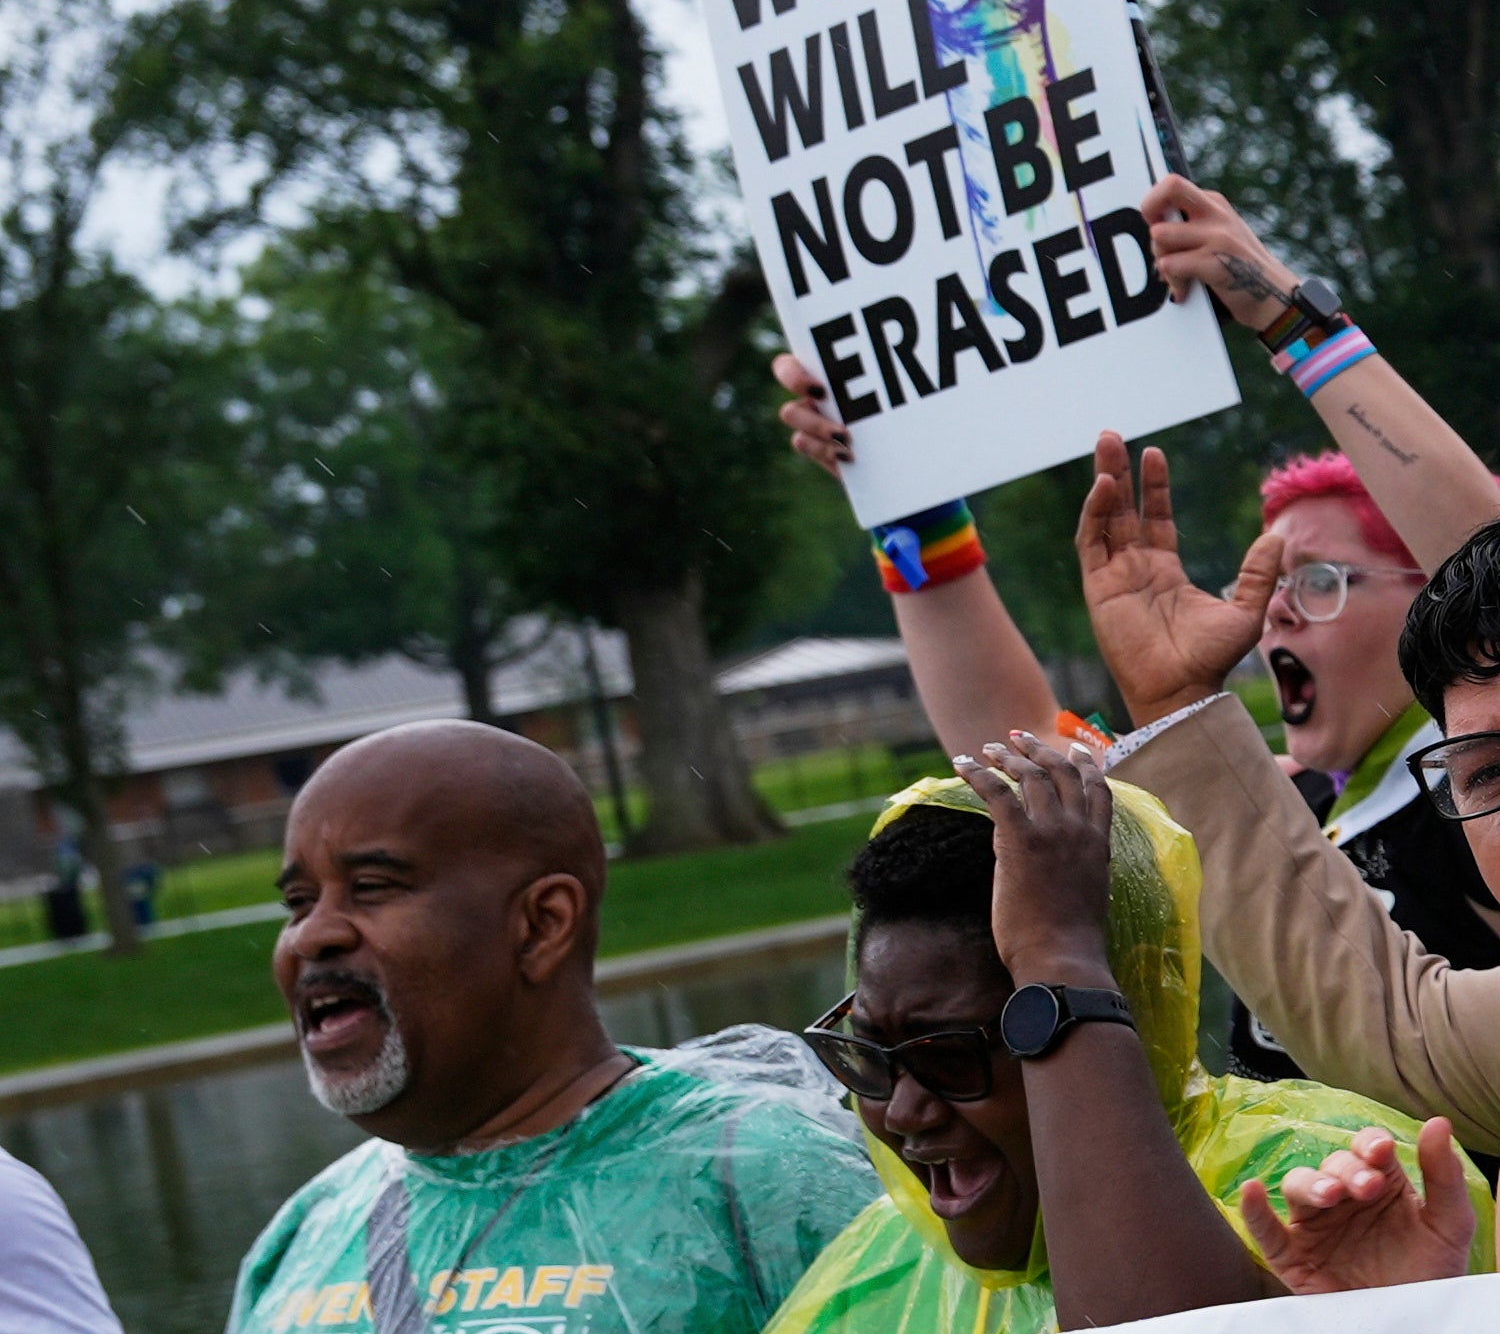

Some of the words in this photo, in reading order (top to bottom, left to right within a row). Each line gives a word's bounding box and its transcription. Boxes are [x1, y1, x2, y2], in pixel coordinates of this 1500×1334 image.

[770, 123, 962, 299] NOT
[984, 69, 1114, 219] BE
[809, 205, 1170, 427] ERASED
[425, 1265, 614, 1316] STAFF
